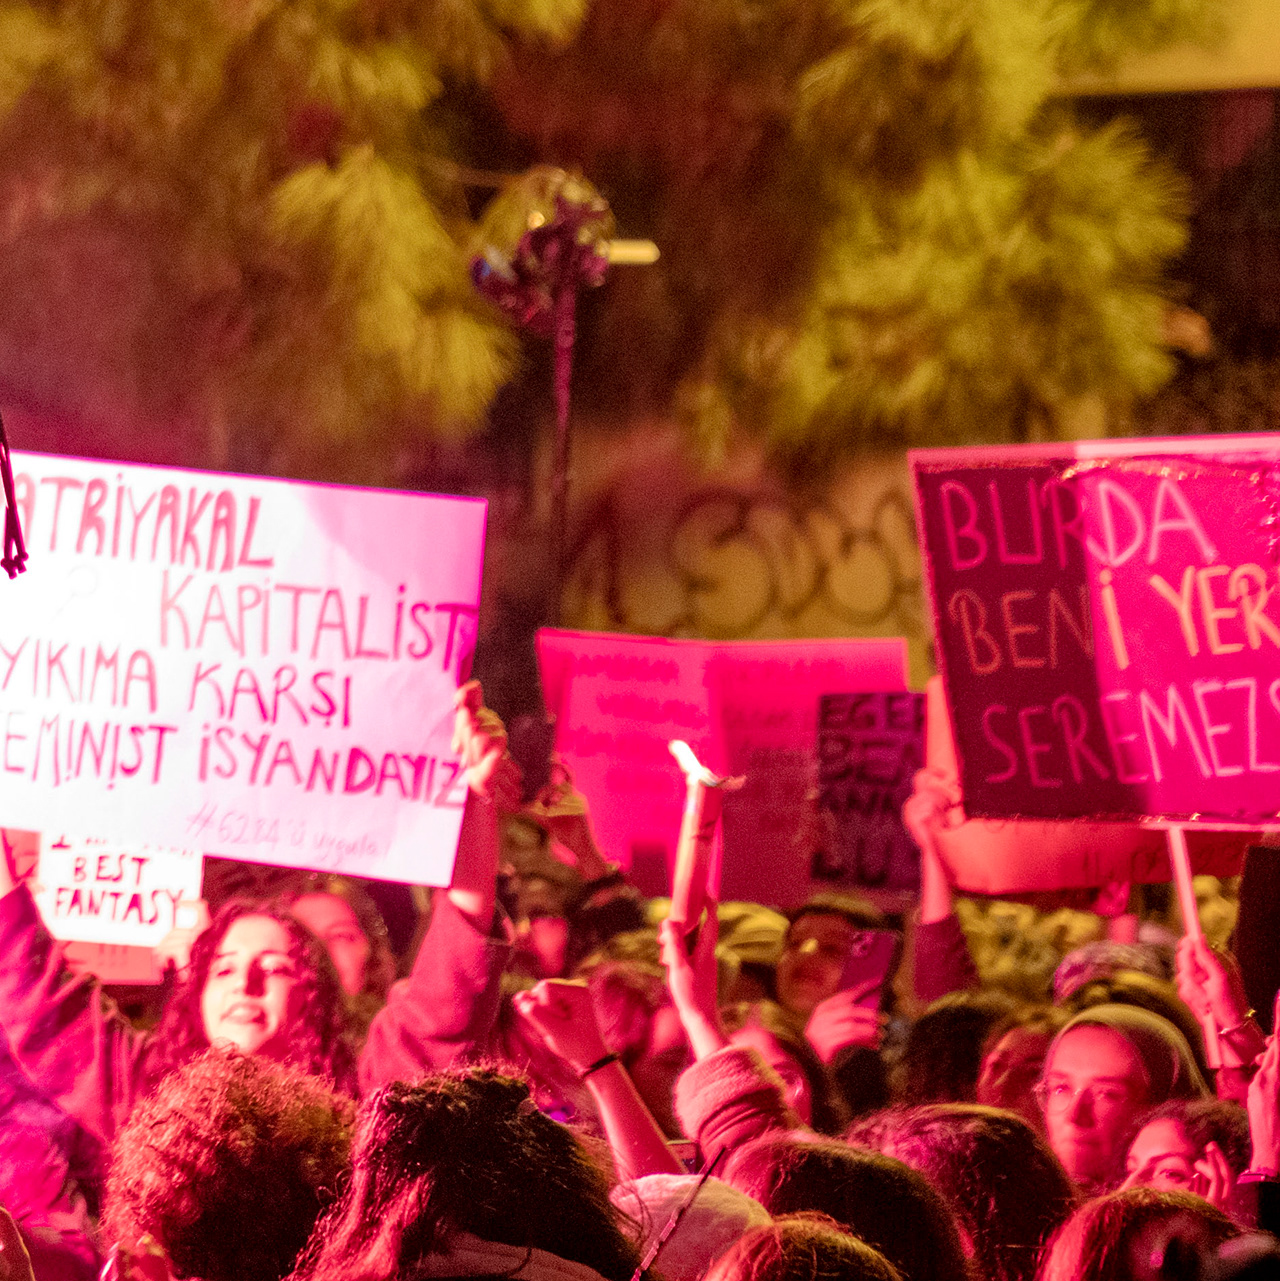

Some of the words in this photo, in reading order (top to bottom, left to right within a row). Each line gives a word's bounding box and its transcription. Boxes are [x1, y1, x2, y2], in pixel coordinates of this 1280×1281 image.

[940, 480, 1219, 571] BURDA
[161, 570, 479, 672] KAPİTALİST
[189, 662, 351, 728] KARŞI
[981, 677, 1280, 788] SEREMEZ
[197, 725, 467, 809] İSYANDAYIZ
[54, 886, 185, 929] FANTASY
[73, 853, 150, 886] BEST
